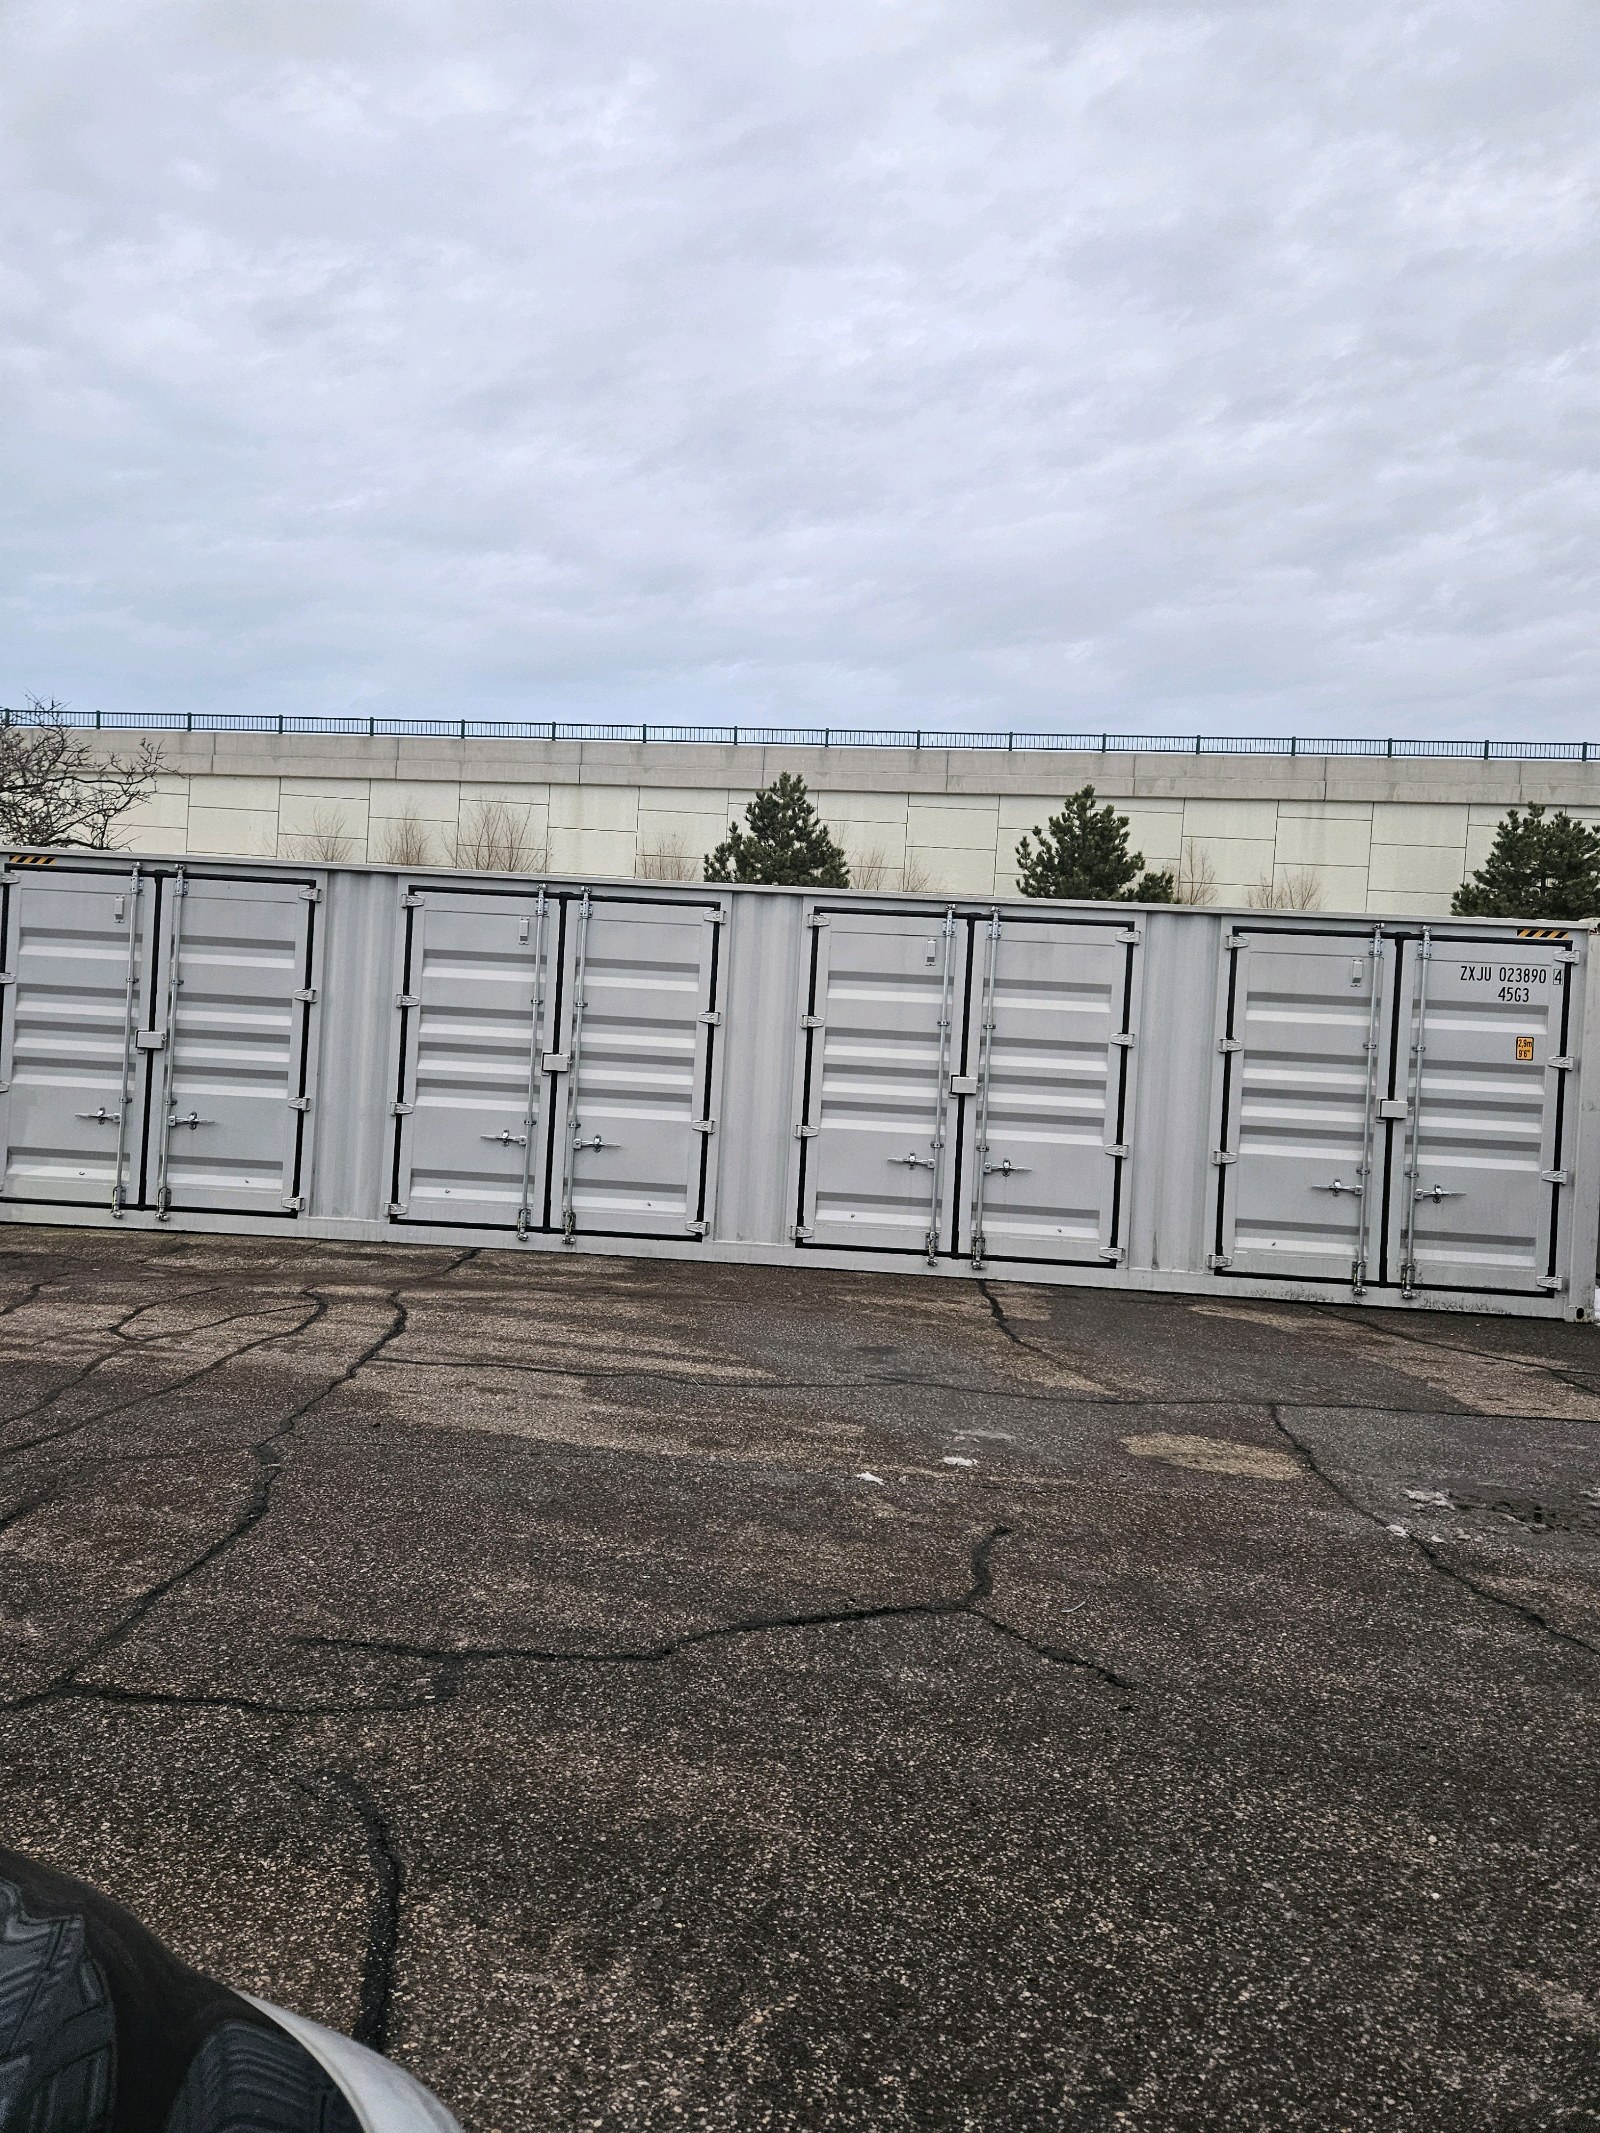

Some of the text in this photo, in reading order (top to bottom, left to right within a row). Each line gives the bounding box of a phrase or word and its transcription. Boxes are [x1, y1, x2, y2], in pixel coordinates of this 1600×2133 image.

[1460, 966, 1563, 985] ZXJU 023890 4
[1498, 986, 1530, 1003] 45G3
